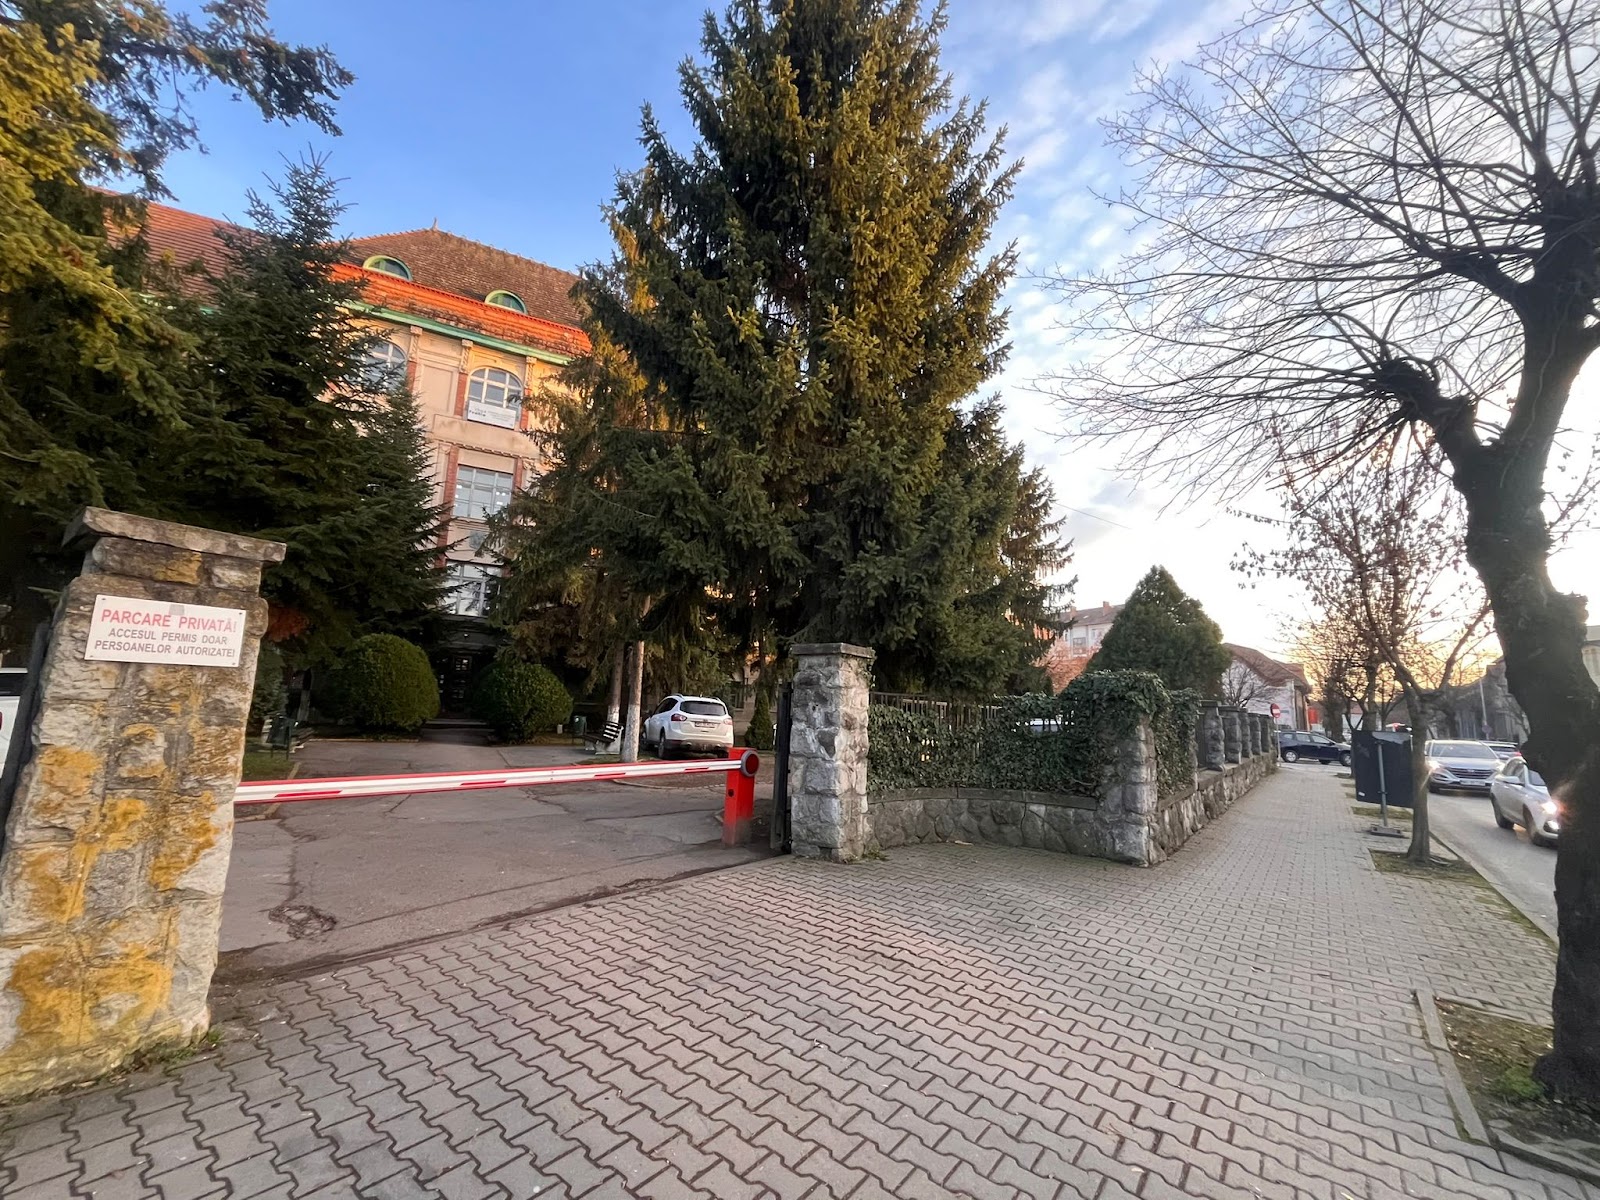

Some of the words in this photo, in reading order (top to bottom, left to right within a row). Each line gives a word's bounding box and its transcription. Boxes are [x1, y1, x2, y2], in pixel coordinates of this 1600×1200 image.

[101, 609, 172, 627] PARCARE
[178, 616, 237, 633] PRIVATĂ!
[108, 628, 157, 640] ACCESUL
[161, 632, 197, 643] PERMIS
[201, 635, 228, 645] DOAR
[94, 640, 171, 654] PERSOANELOR
